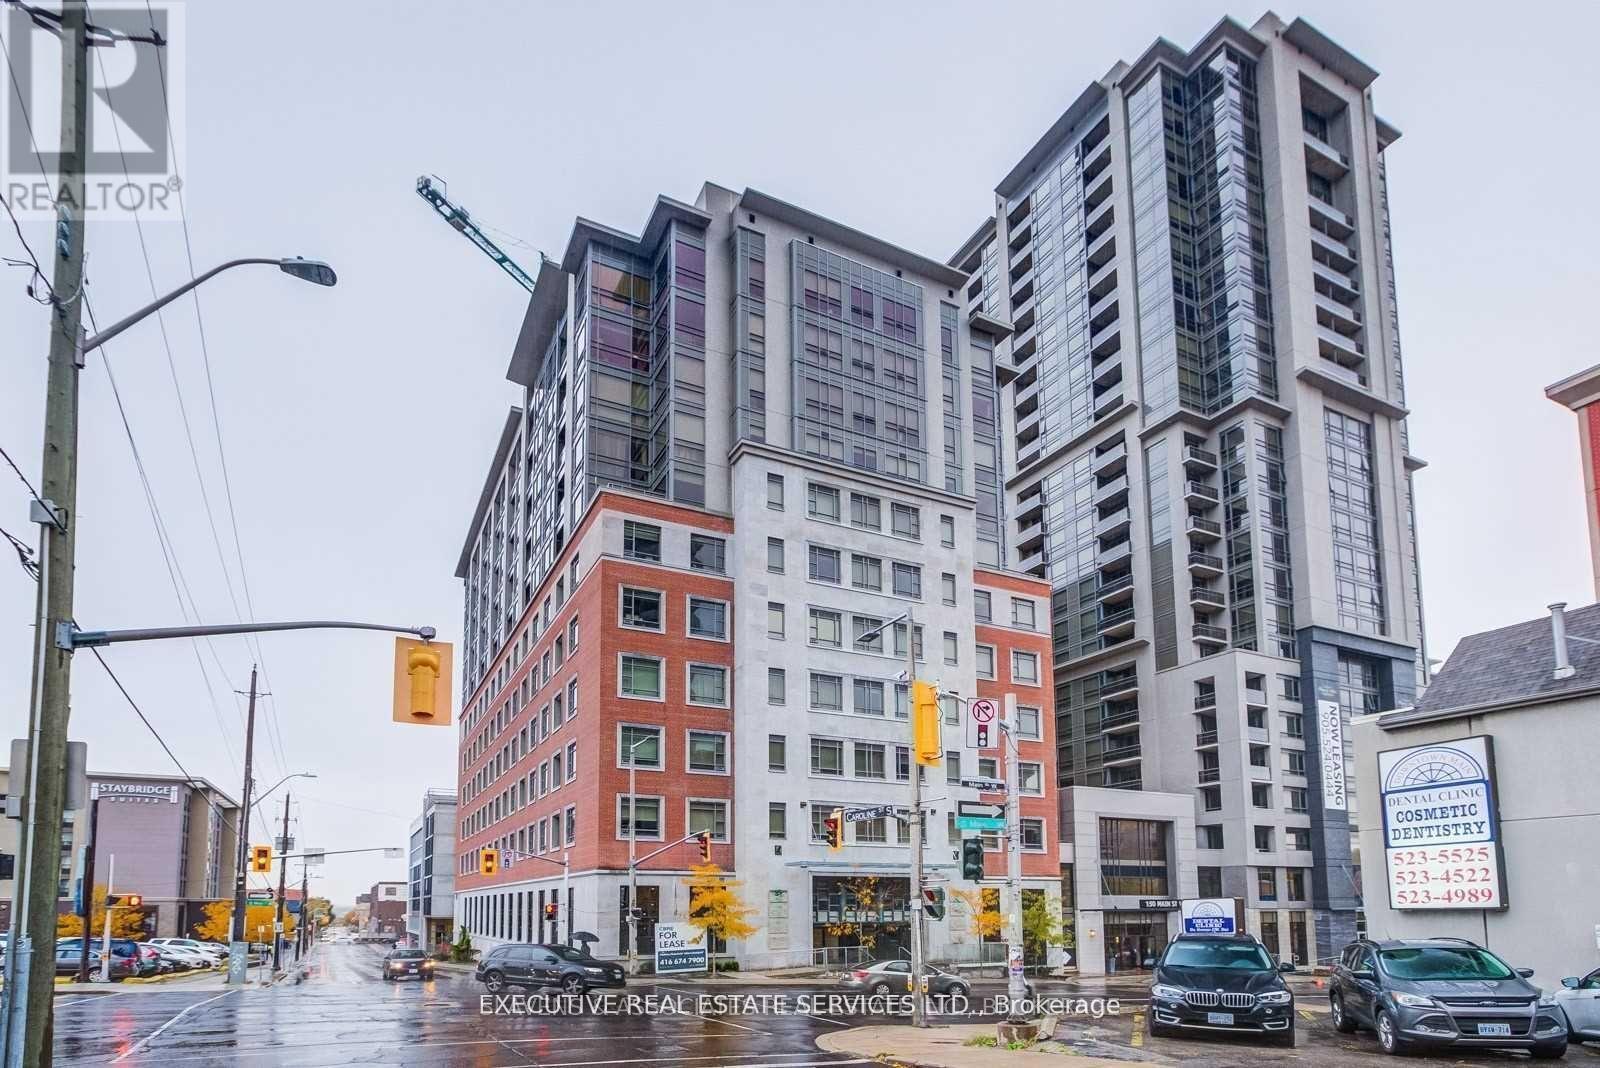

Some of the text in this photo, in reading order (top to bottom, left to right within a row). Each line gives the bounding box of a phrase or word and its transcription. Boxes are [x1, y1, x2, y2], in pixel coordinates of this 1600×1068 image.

[1329, 705, 1344, 806] NOW LEASING
[100, 783, 170, 795] STAYBRIDGE
[1388, 787, 1485, 807] DENTAL CLINIC
[846, 810, 878, 822] CAROLINE
[885, 805, 892, 816] S
[1396, 803, 1478, 823] COSMETIC
[1391, 821, 1486, 841] DENTISTRY
[1393, 847, 1489, 866] 523-5525
[1395, 867, 1491, 885] 523-4522
[1157, 900, 1170, 908] MAIN
[1397, 887, 1493, 905] 523-4989
[659, 940, 686, 949] LEASE
